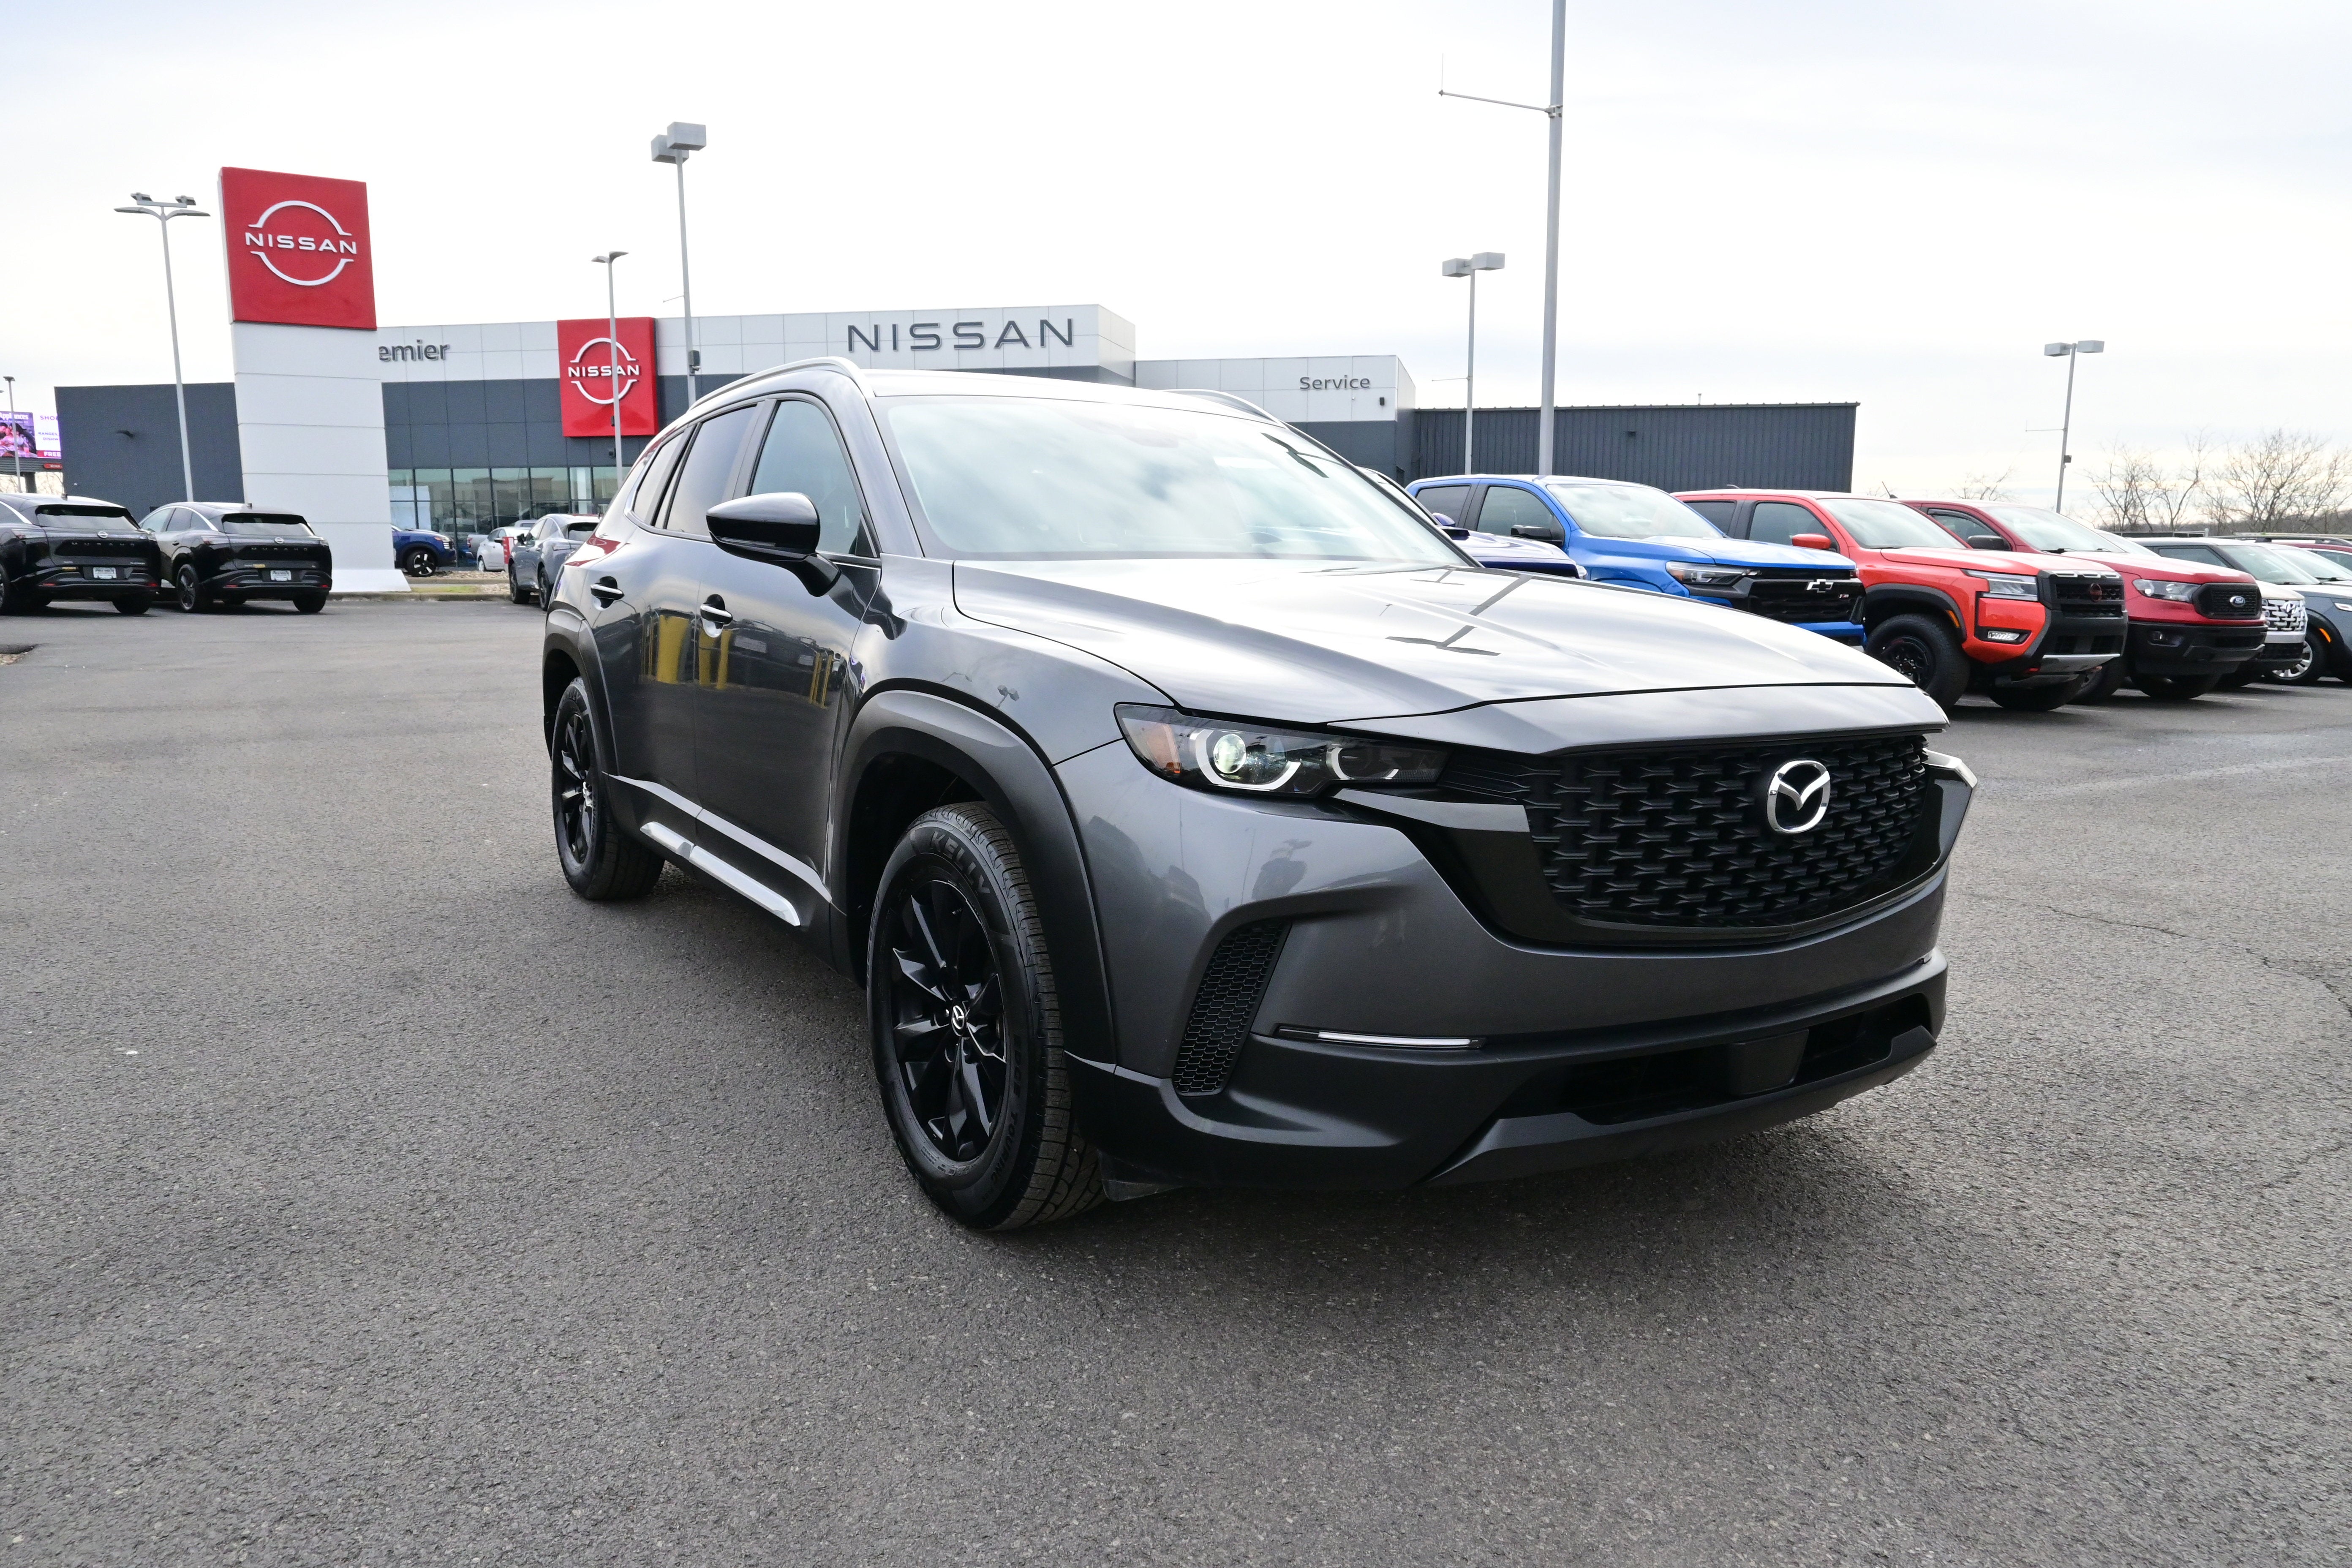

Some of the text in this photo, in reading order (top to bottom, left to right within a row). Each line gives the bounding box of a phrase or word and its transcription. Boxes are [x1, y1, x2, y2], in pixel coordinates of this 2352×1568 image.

[245, 232, 357, 254] NISSAN
[847, 318, 1074, 352] NISSAN
[568, 365, 640, 377] NISSAN
[1299, 375, 1371, 390] Service
[930, 831, 991, 894] KELLY
